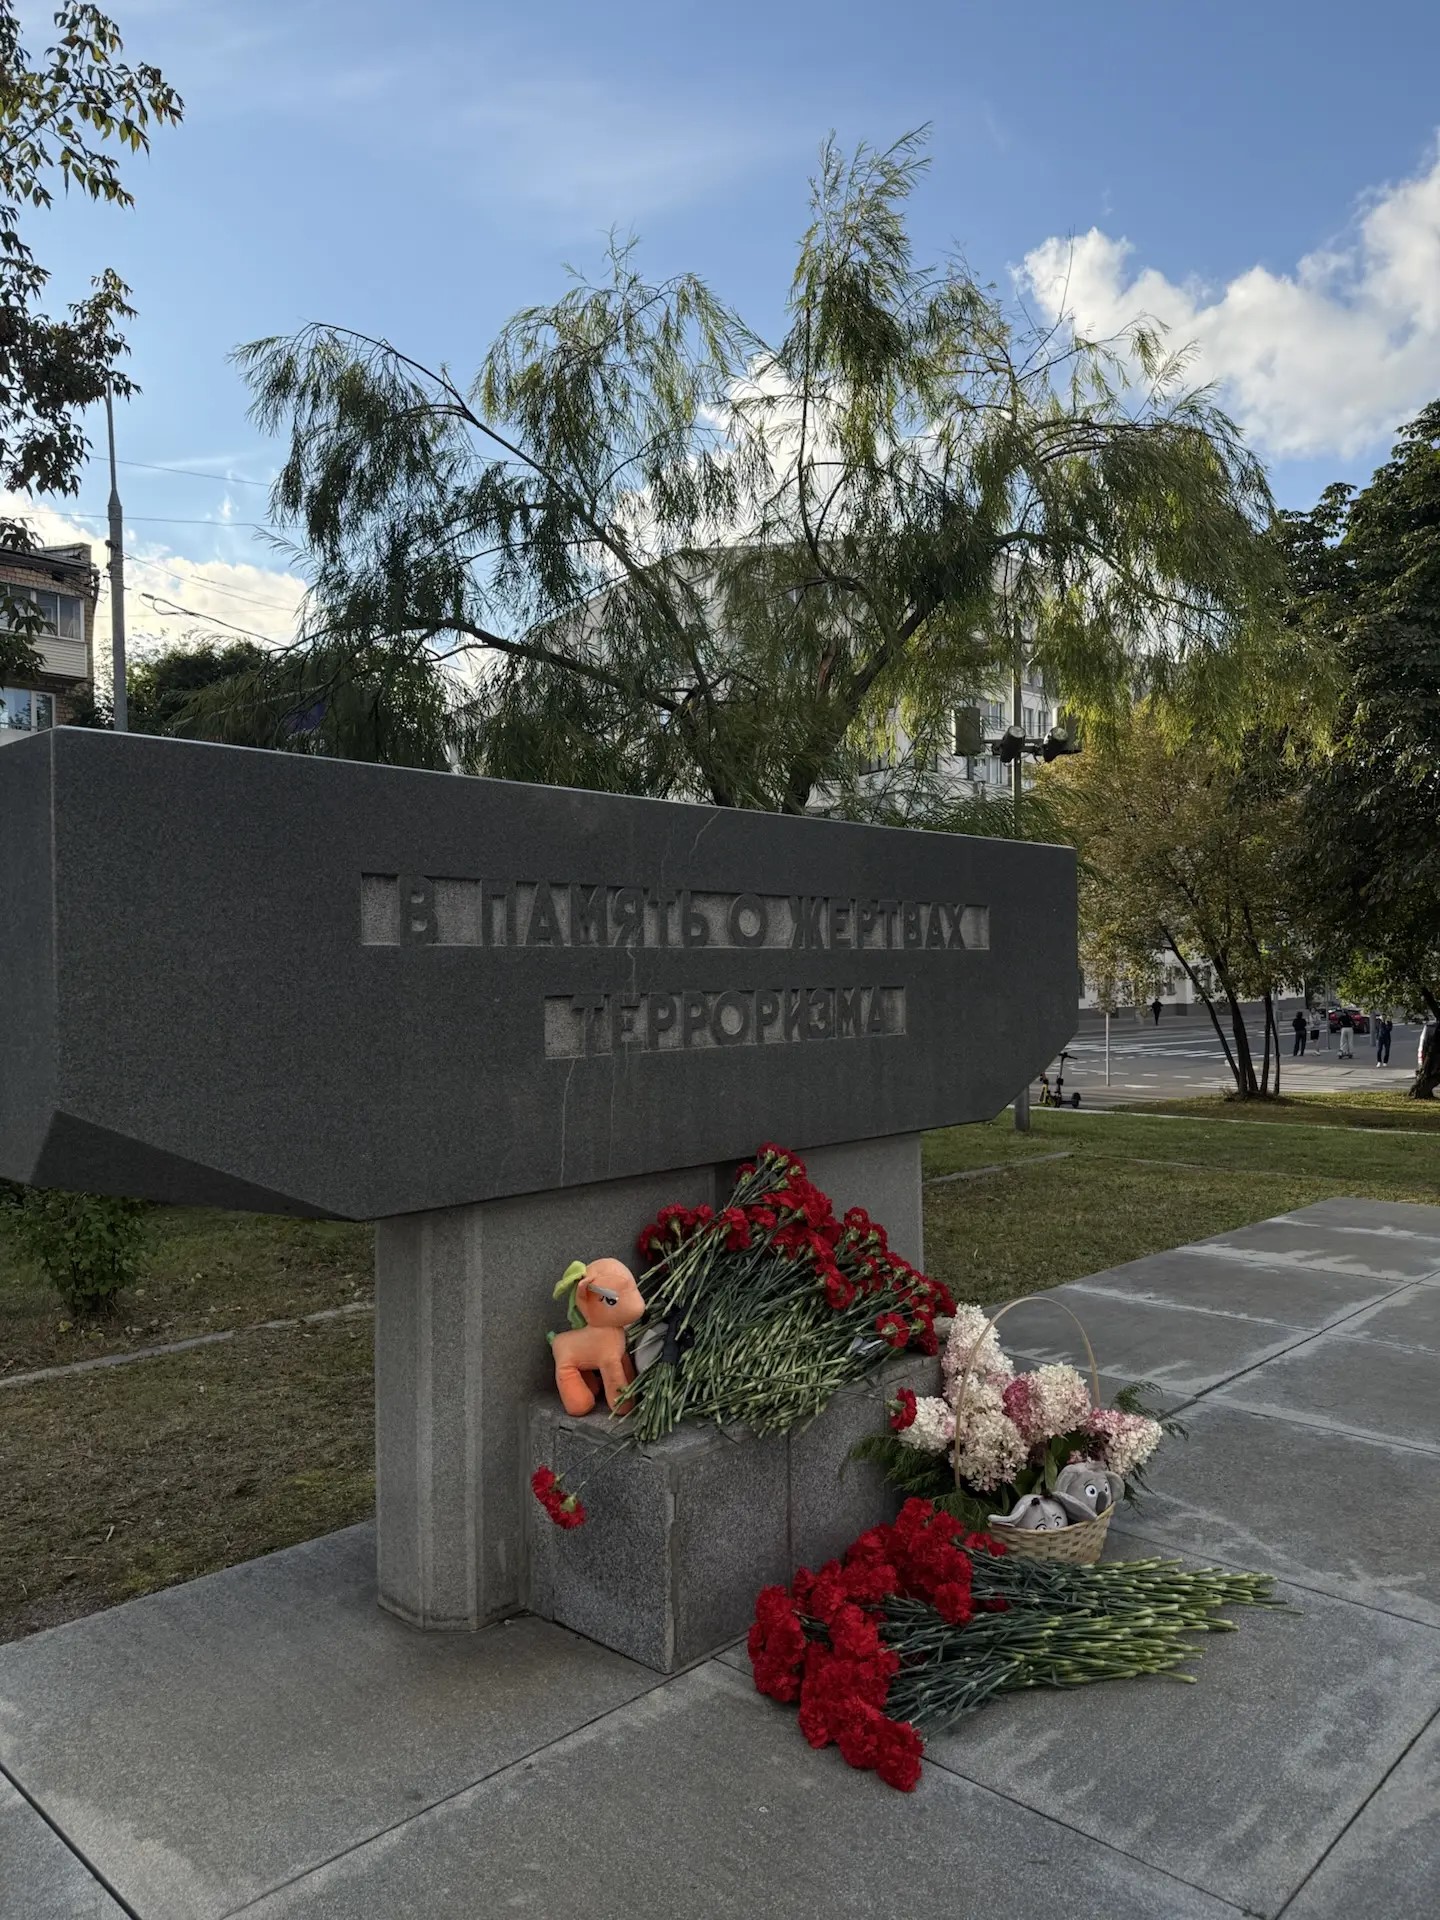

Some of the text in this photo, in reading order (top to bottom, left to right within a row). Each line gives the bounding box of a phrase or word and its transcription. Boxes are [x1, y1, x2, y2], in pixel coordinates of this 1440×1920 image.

[399, 874, 966, 950] В ПАМЯТЬ О ЖЕРТВАХ
[574, 986, 890, 1056] ТЕРРОРИЗМА
